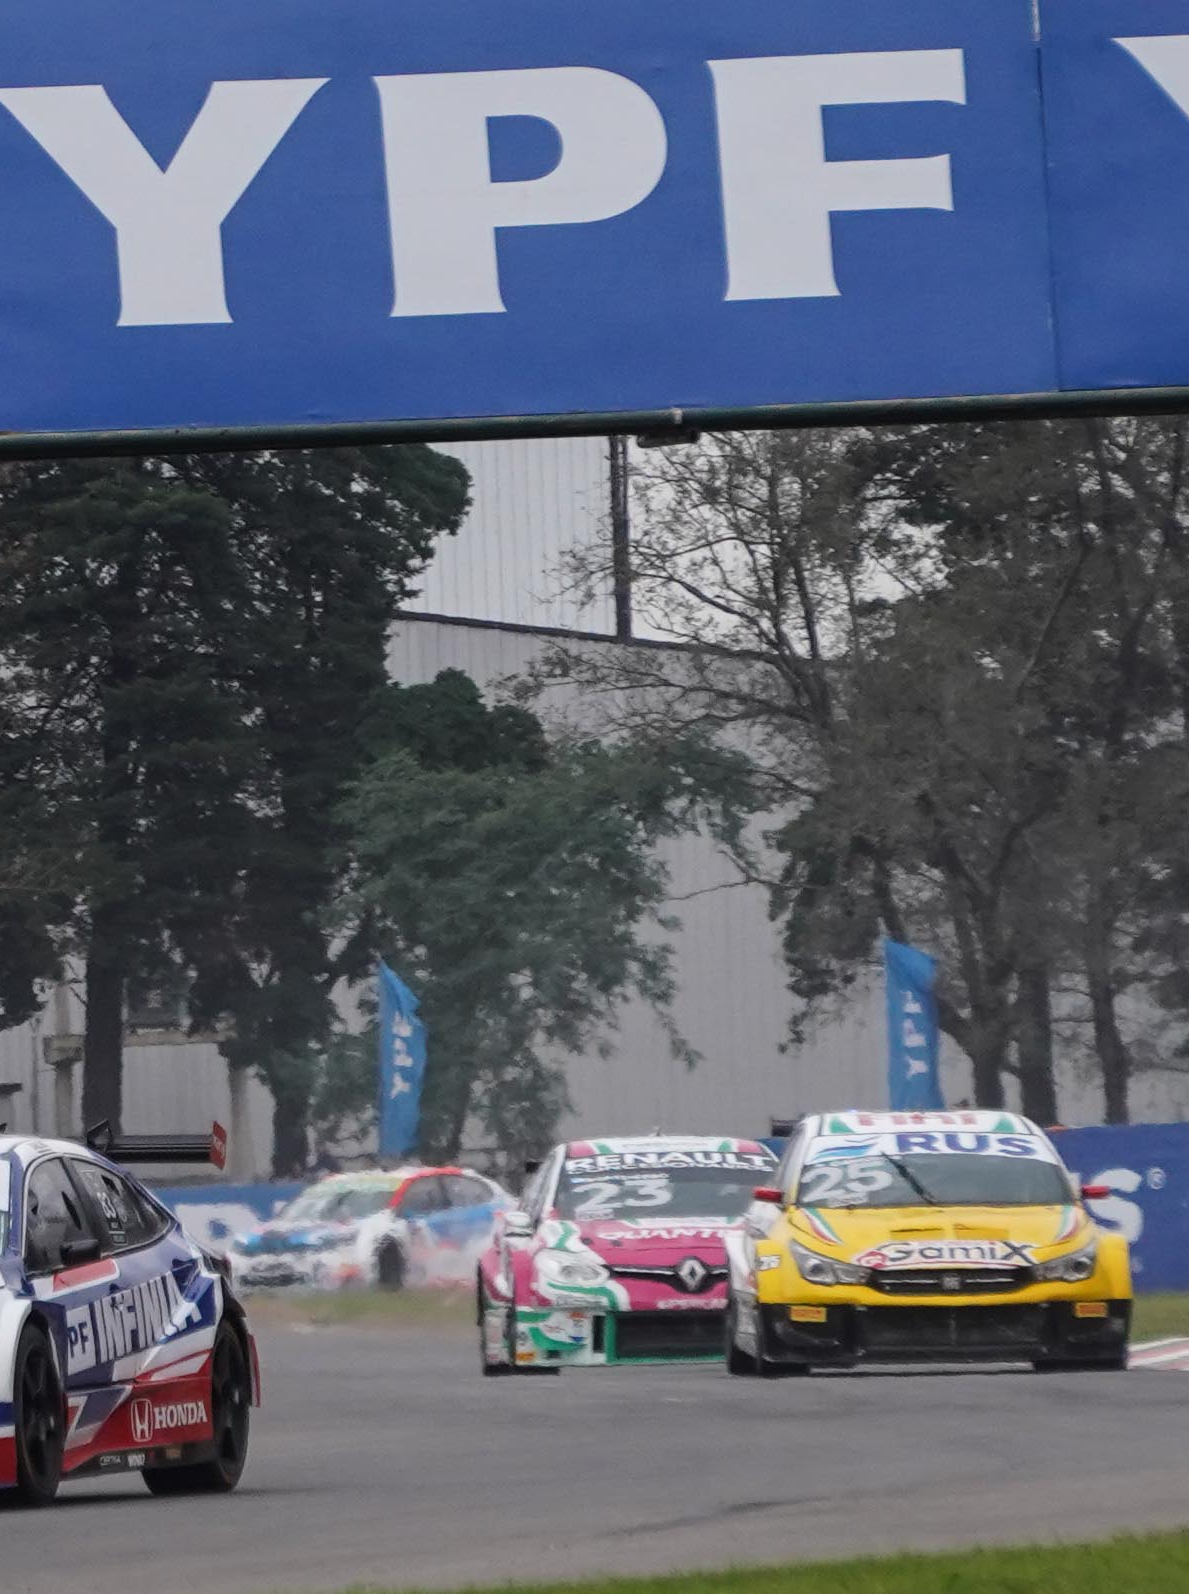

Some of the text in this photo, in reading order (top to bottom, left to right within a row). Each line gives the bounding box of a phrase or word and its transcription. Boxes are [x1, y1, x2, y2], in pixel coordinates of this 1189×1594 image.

[895, 1133, 1038, 1156] RUS
[565, 1152, 772, 1172] RENAULT
[801, 1157, 893, 1203] 25
[572, 1178, 673, 1219] 23
[93, 1271, 203, 1364] INFINIA
[154, 1401, 208, 1429] HONDA
